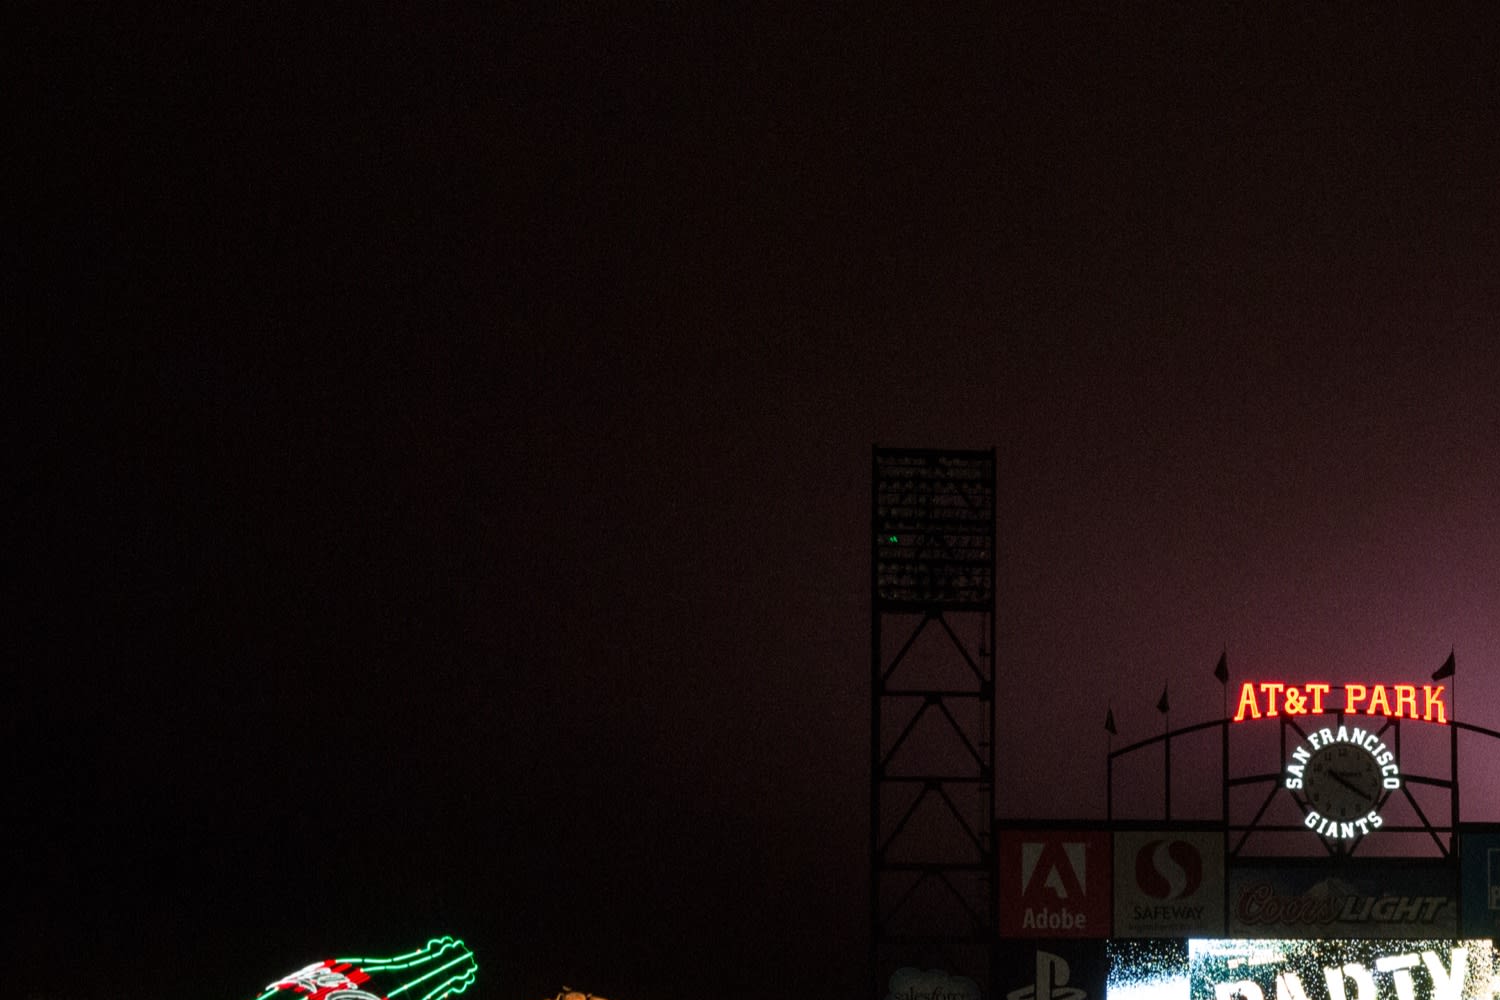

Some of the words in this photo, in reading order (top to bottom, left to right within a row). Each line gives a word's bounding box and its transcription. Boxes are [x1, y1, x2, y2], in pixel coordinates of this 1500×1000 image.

[1233, 682, 1330, 722] AT&T
[1344, 684, 1447, 724] PARK
[1285, 745, 1311, 790] SAN
[1307, 725, 1400, 790] FRANCISCO
[1304, 810, 1383, 839] GIANTS
[1022, 907, 1087, 930] Adobe
[1133, 905, 1205, 921] SAFEWAY
[1237, 880, 1345, 926] Coors
[1338, 895, 1446, 924] LIGHT
